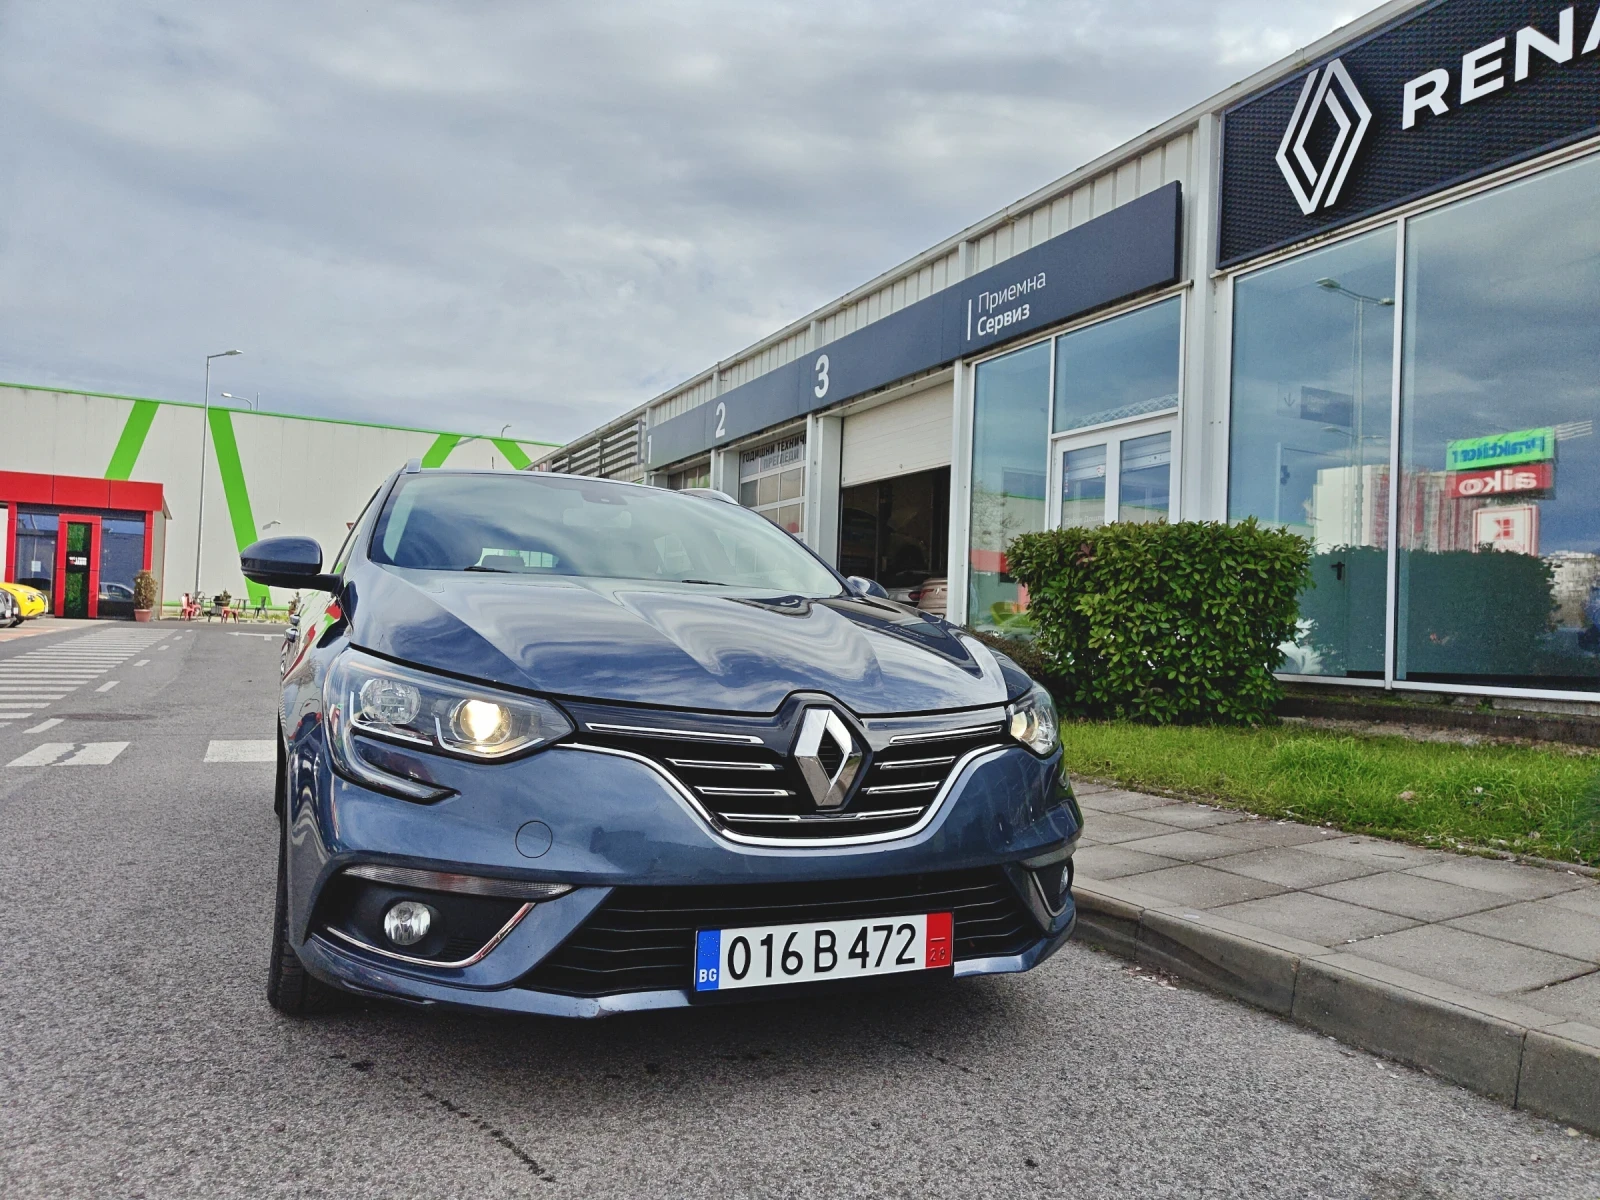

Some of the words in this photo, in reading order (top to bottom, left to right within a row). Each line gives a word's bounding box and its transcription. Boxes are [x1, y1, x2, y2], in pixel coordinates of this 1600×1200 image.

[978, 272, 1046, 314] Приемна
[977, 303, 1030, 336] Сервиз
[814, 354, 830, 398] 3
[715, 401, 726, 439] 2
[647, 434, 652, 465] 1
[742, 443, 775, 463] ГОДИШНИ
[777, 434, 806, 451] ТЕХНИЧ
[763, 447, 799, 469] ПРЕГЛЕДИ
[699, 968, 717, 983] BG
